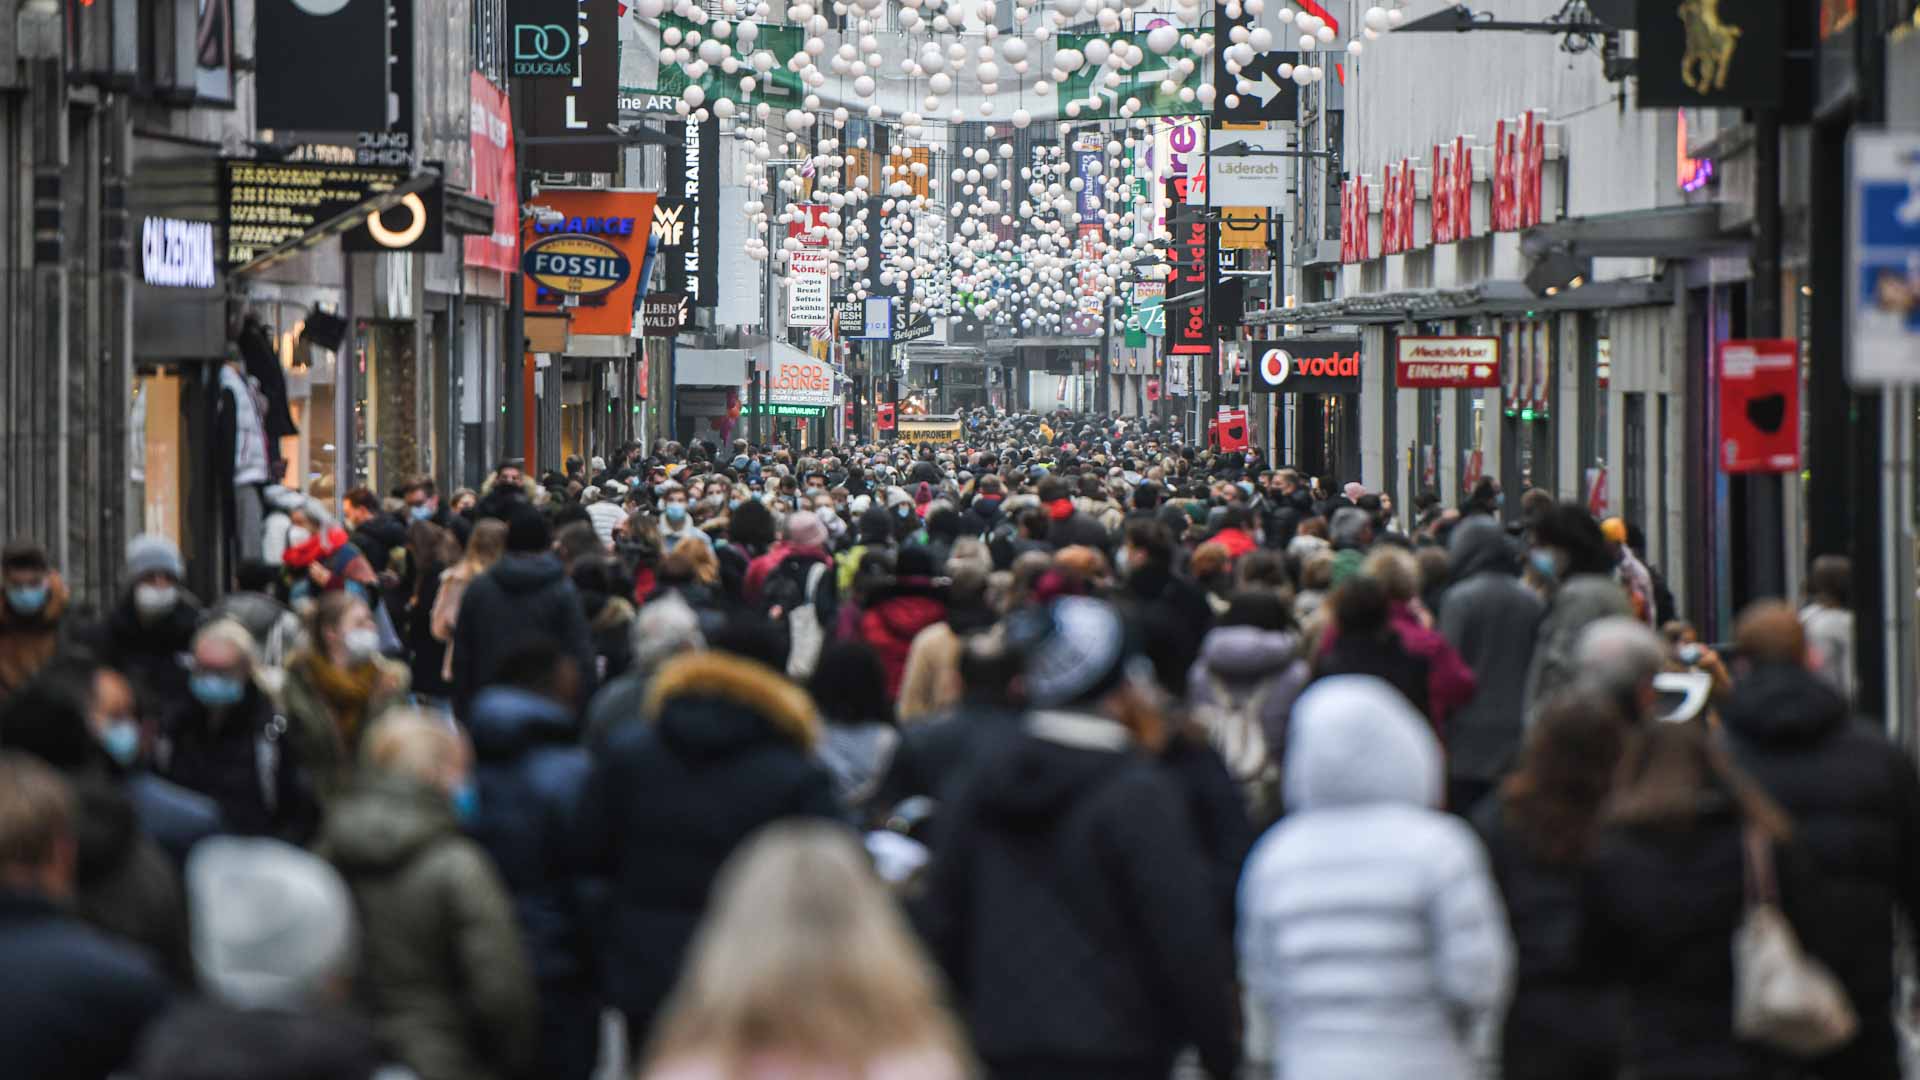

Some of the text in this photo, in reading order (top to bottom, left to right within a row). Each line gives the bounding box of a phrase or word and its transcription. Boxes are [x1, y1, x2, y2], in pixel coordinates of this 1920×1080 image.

[515, 62, 571, 74] DOUGLAS
[1218, 162, 1278, 174] Läderach
[535, 254, 620, 278] FOSSIL
[791, 264, 826, 275] Köng
[836, 302, 862, 311] USH
[893, 325, 931, 340] Belgique
[781, 365, 823, 377] FOOD
[1407, 364, 1468, 379] EINGANG
[772, 377, 830, 390] LOUNGE
